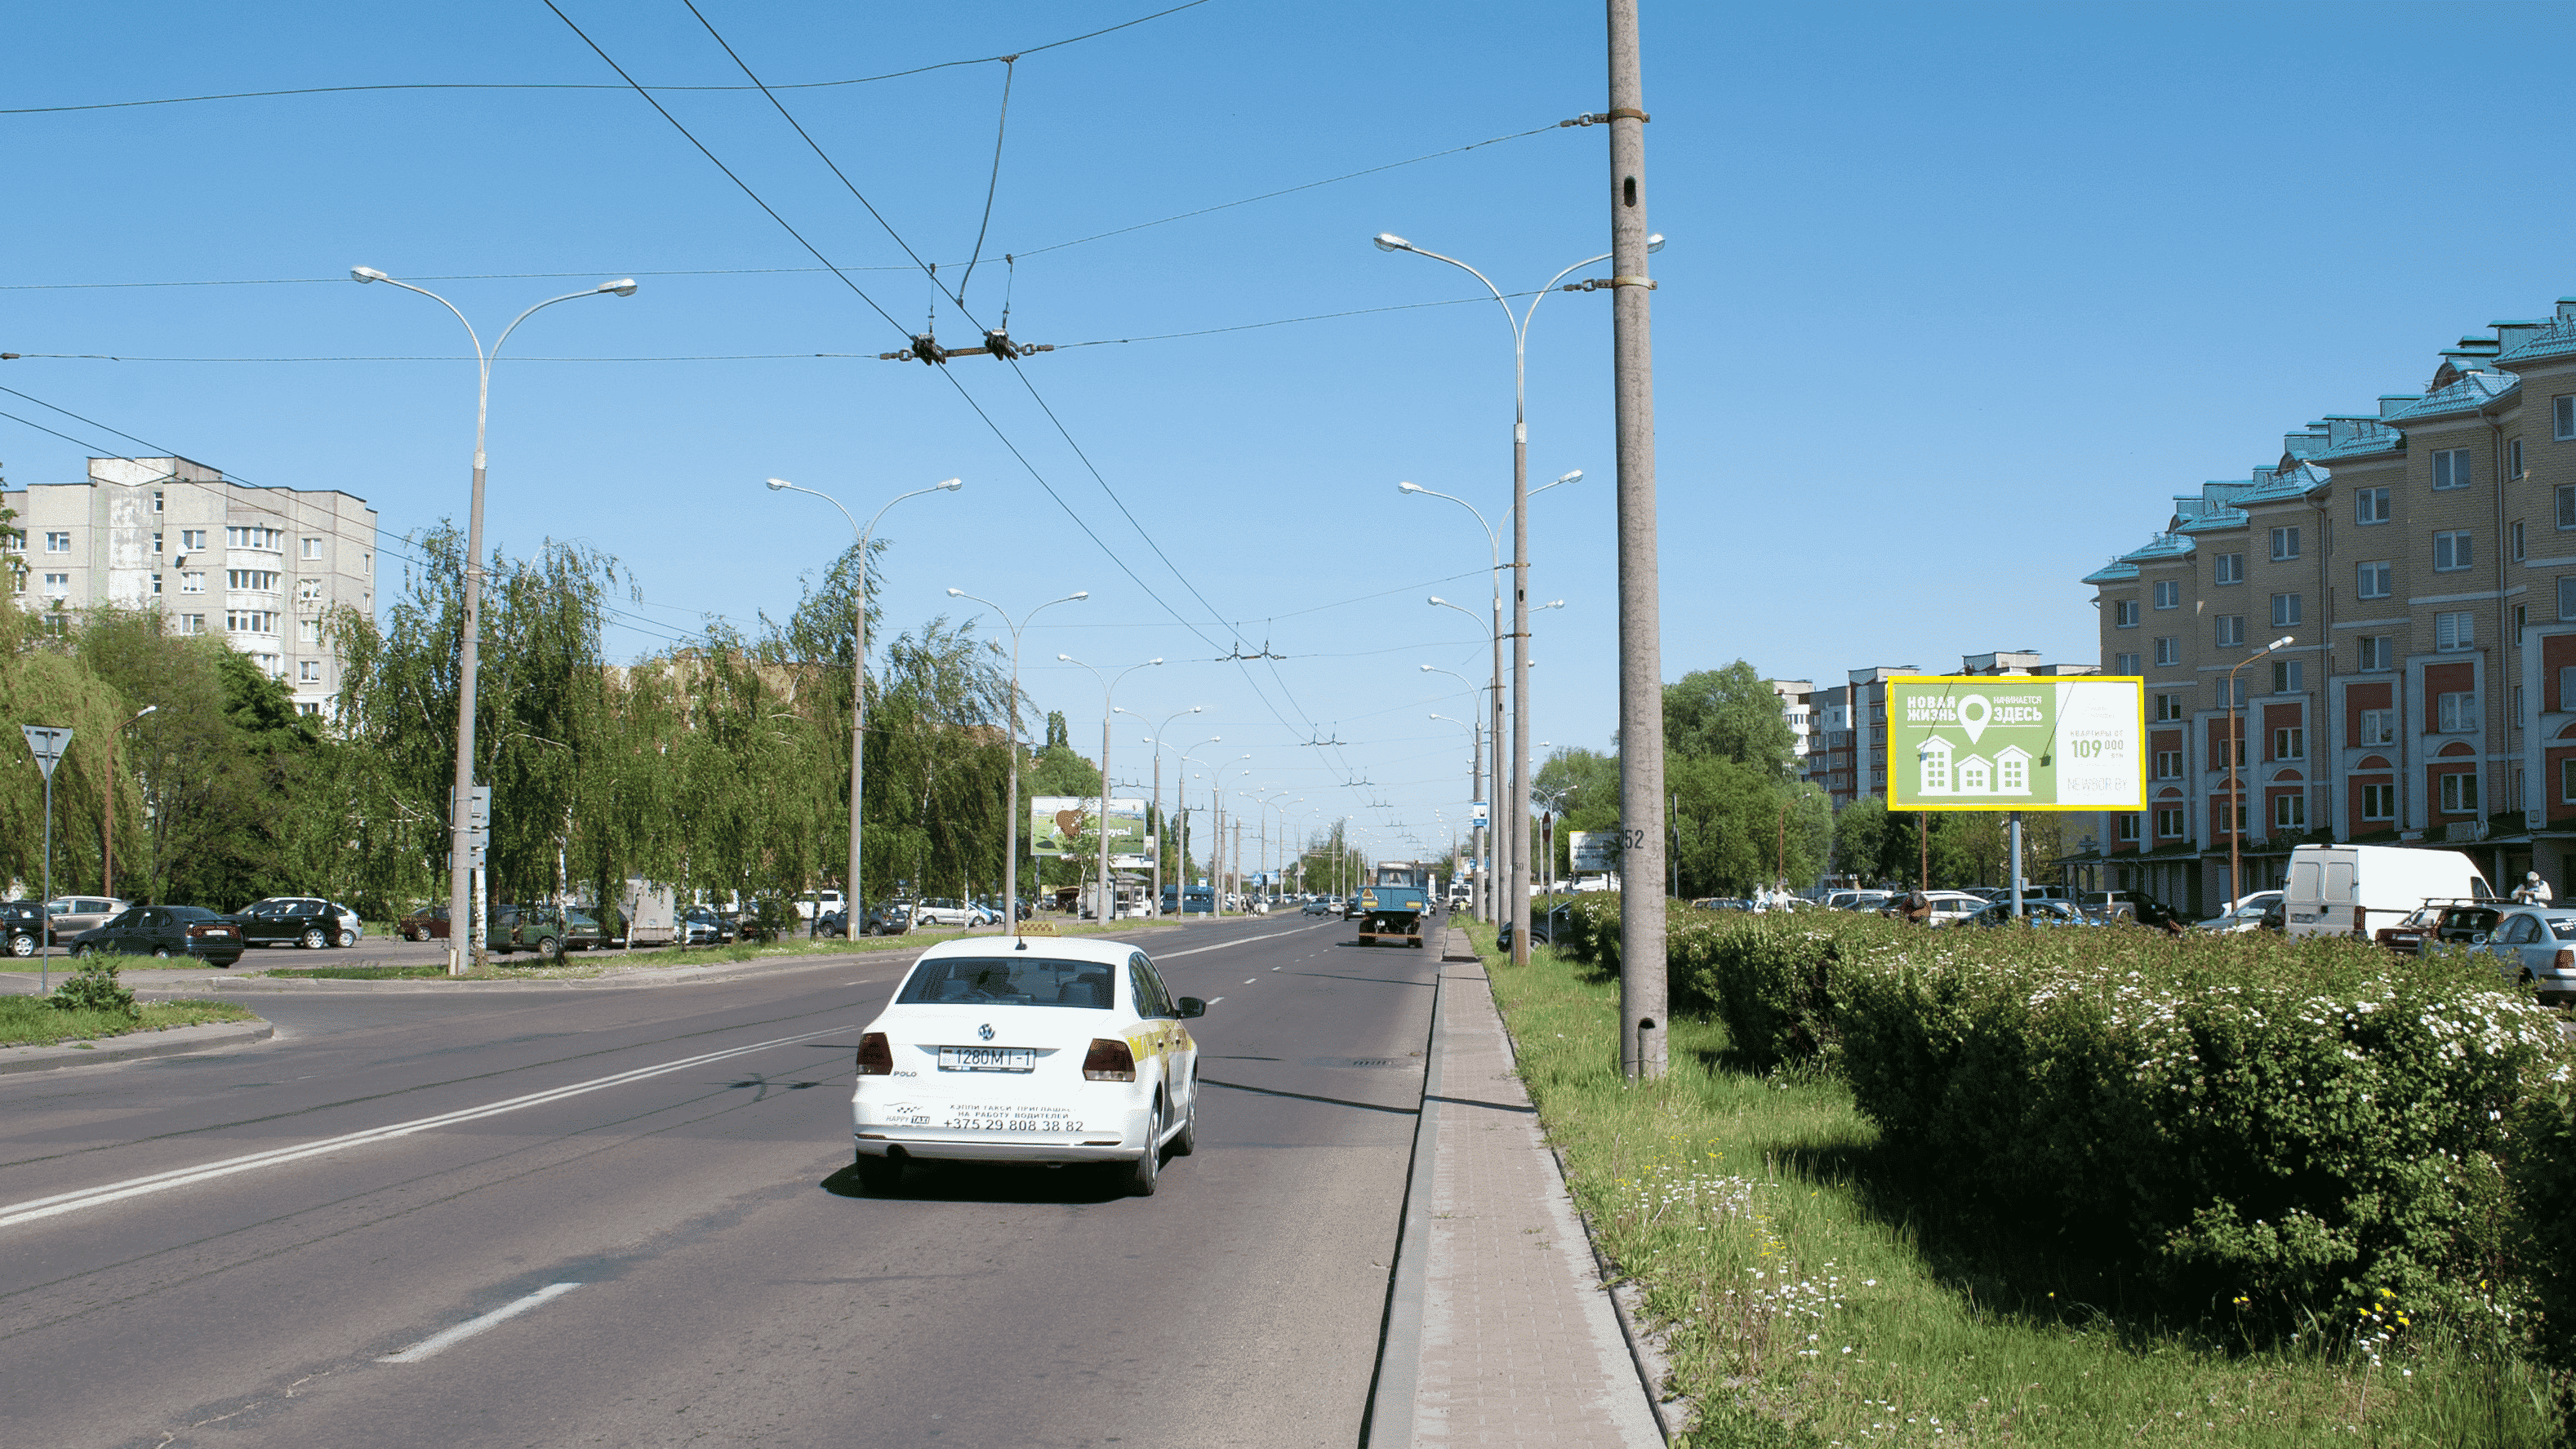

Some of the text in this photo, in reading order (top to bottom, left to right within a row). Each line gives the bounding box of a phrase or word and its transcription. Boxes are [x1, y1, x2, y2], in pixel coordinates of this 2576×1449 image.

[1907, 696, 1956, 709] НОВАЯ
[1907, 709, 1957, 722] ЖИЗНЬ
[1993, 706, 2044, 724] ЗДЕСЬ
[2071, 739, 2124, 758] 109 000
[893, 1070, 918, 1078] POLO
[943, 1118, 1084, 1132] +375 29 808 38 82
